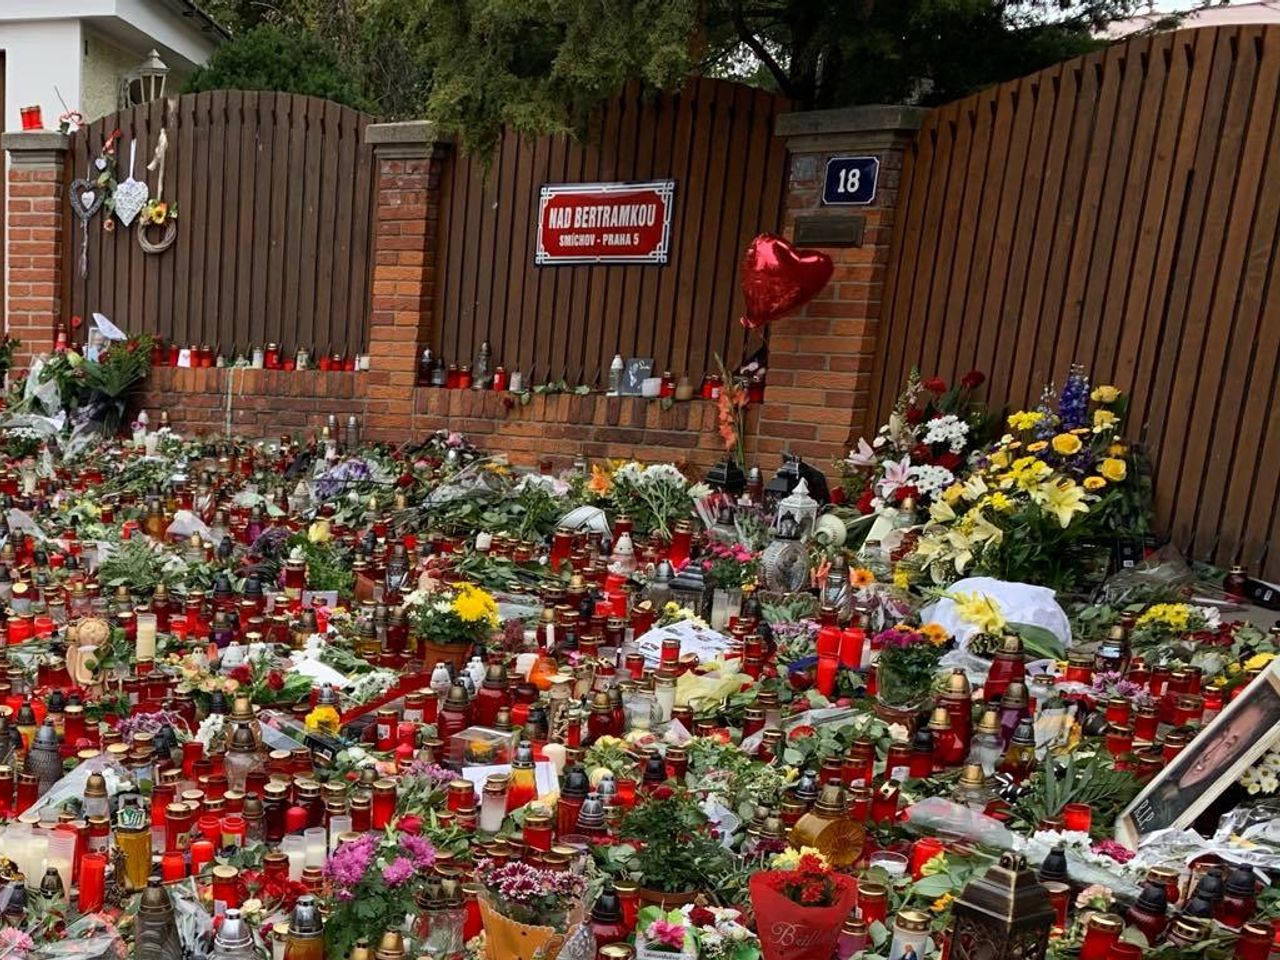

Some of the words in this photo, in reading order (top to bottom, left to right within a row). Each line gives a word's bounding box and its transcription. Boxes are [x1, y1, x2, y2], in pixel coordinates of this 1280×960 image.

[837, 168, 861, 193] 18
[549, 208, 572, 228] NAD
[574, 204, 656, 228] BERTRAMKOU
[559, 232, 595, 247] SMÍCHOV
[602, 233, 631, 246] PRAHA
[633, 232, 640, 245] 5
